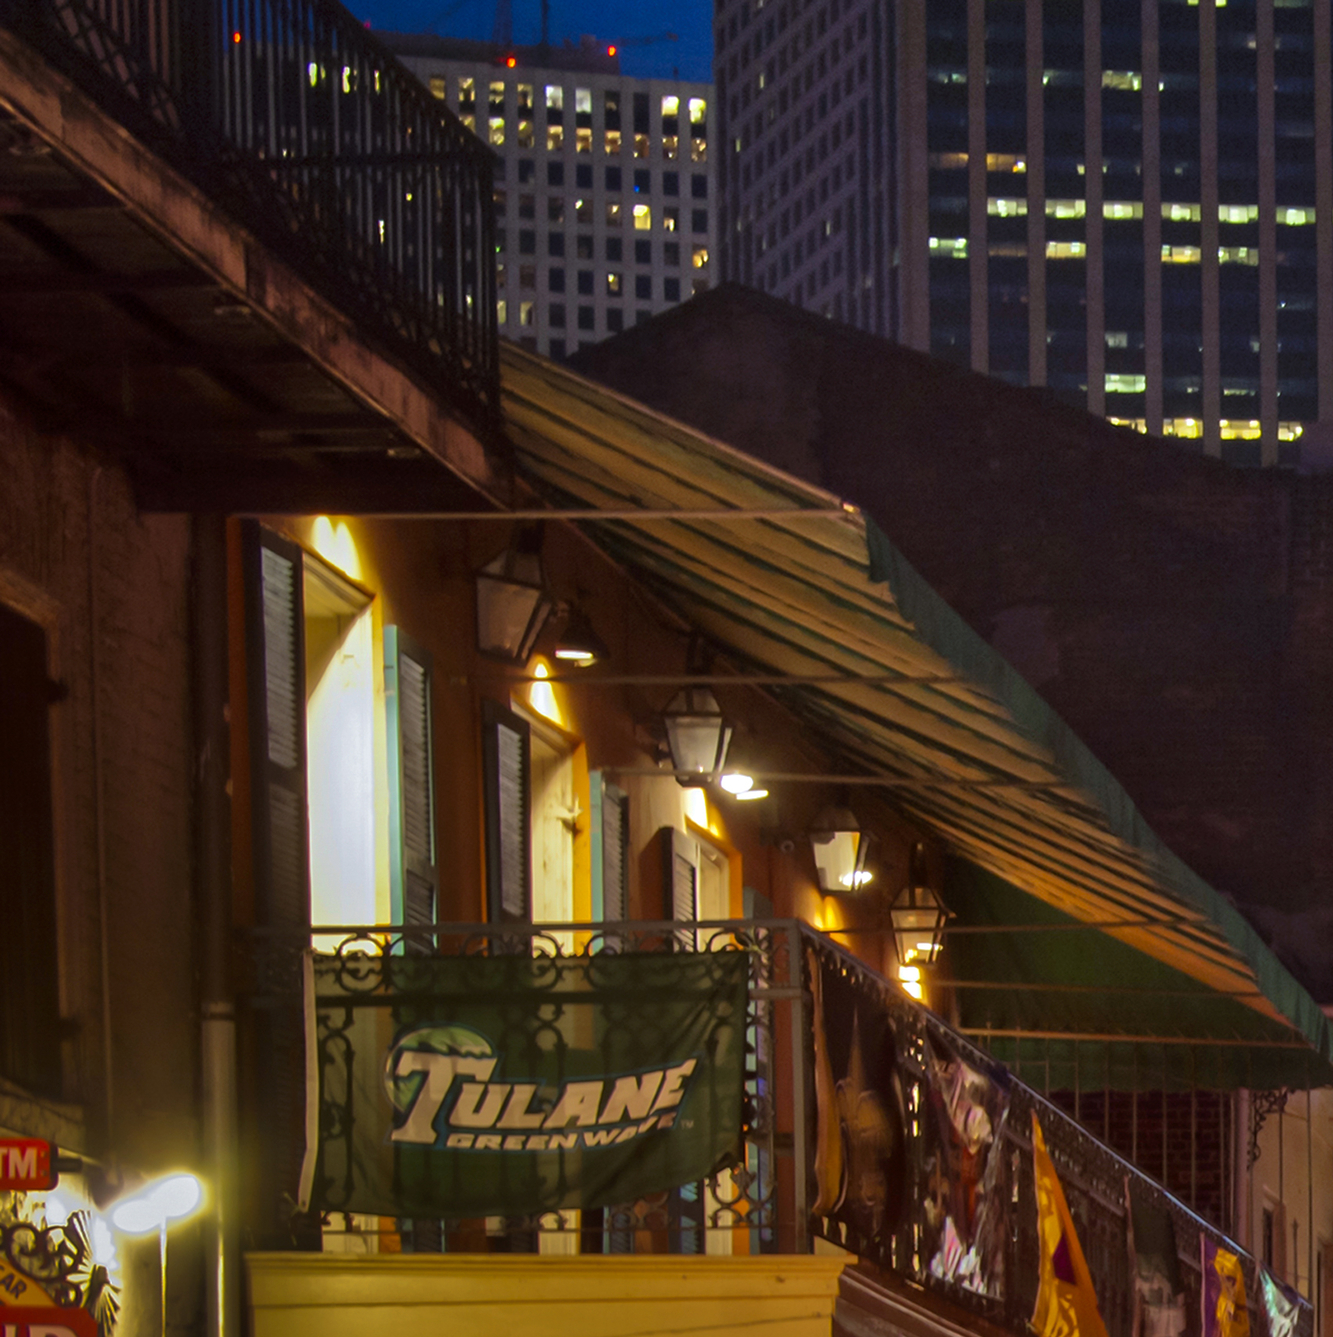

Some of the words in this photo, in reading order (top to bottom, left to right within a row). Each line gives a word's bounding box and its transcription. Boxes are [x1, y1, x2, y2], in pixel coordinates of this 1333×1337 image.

[391, 1051, 698, 1144] TULANE
[446, 1133, 577, 1150] GREEN
[583, 1113, 677, 1147] WAVE
[0, 1264, 27, 1299] AR
